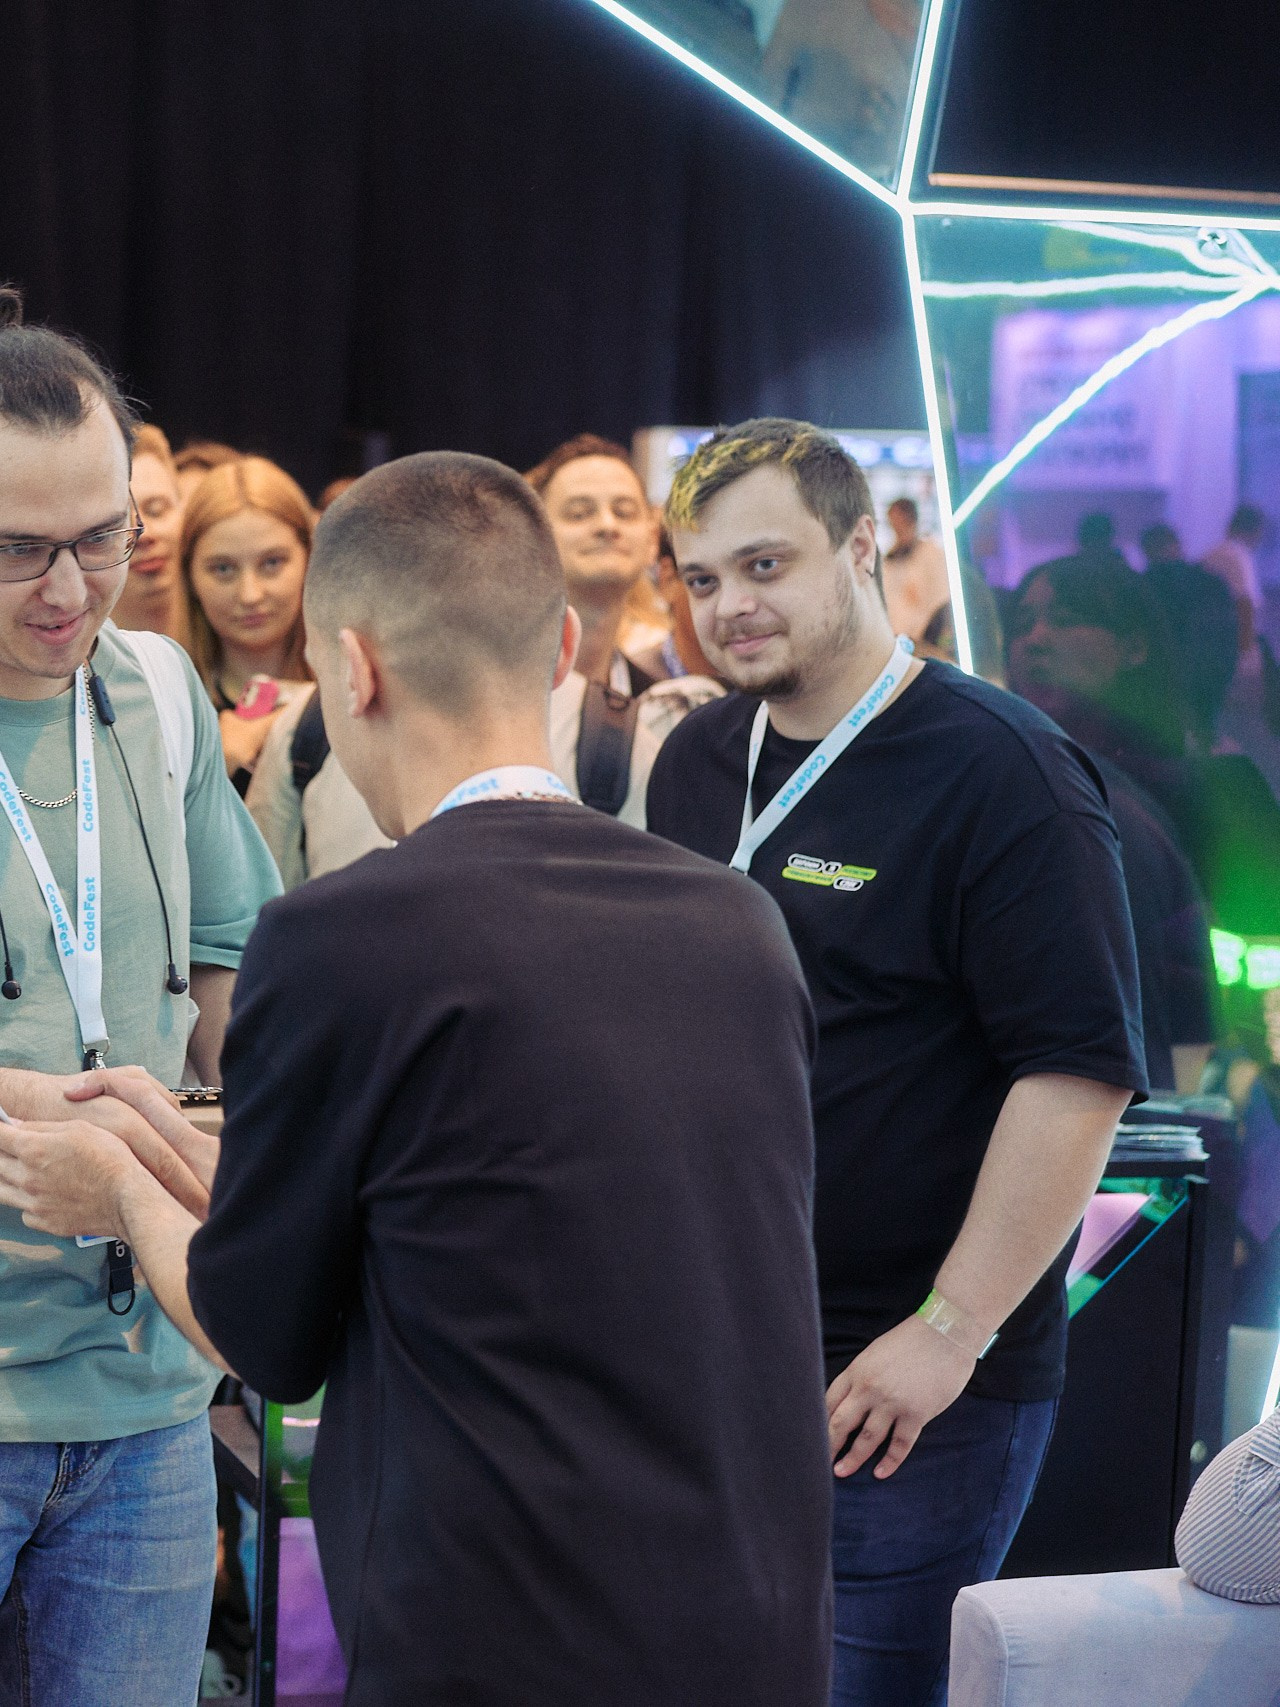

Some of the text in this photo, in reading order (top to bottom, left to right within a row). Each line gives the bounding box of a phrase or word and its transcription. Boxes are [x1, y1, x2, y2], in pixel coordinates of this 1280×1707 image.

[848, 674, 895, 728] CodeFest
[82, 758, 95, 833] CodeFest
[777, 754, 827, 808] CodeFest
[45, 883, 75, 957] CodeFest
[83, 876, 96, 952] CodeFest
